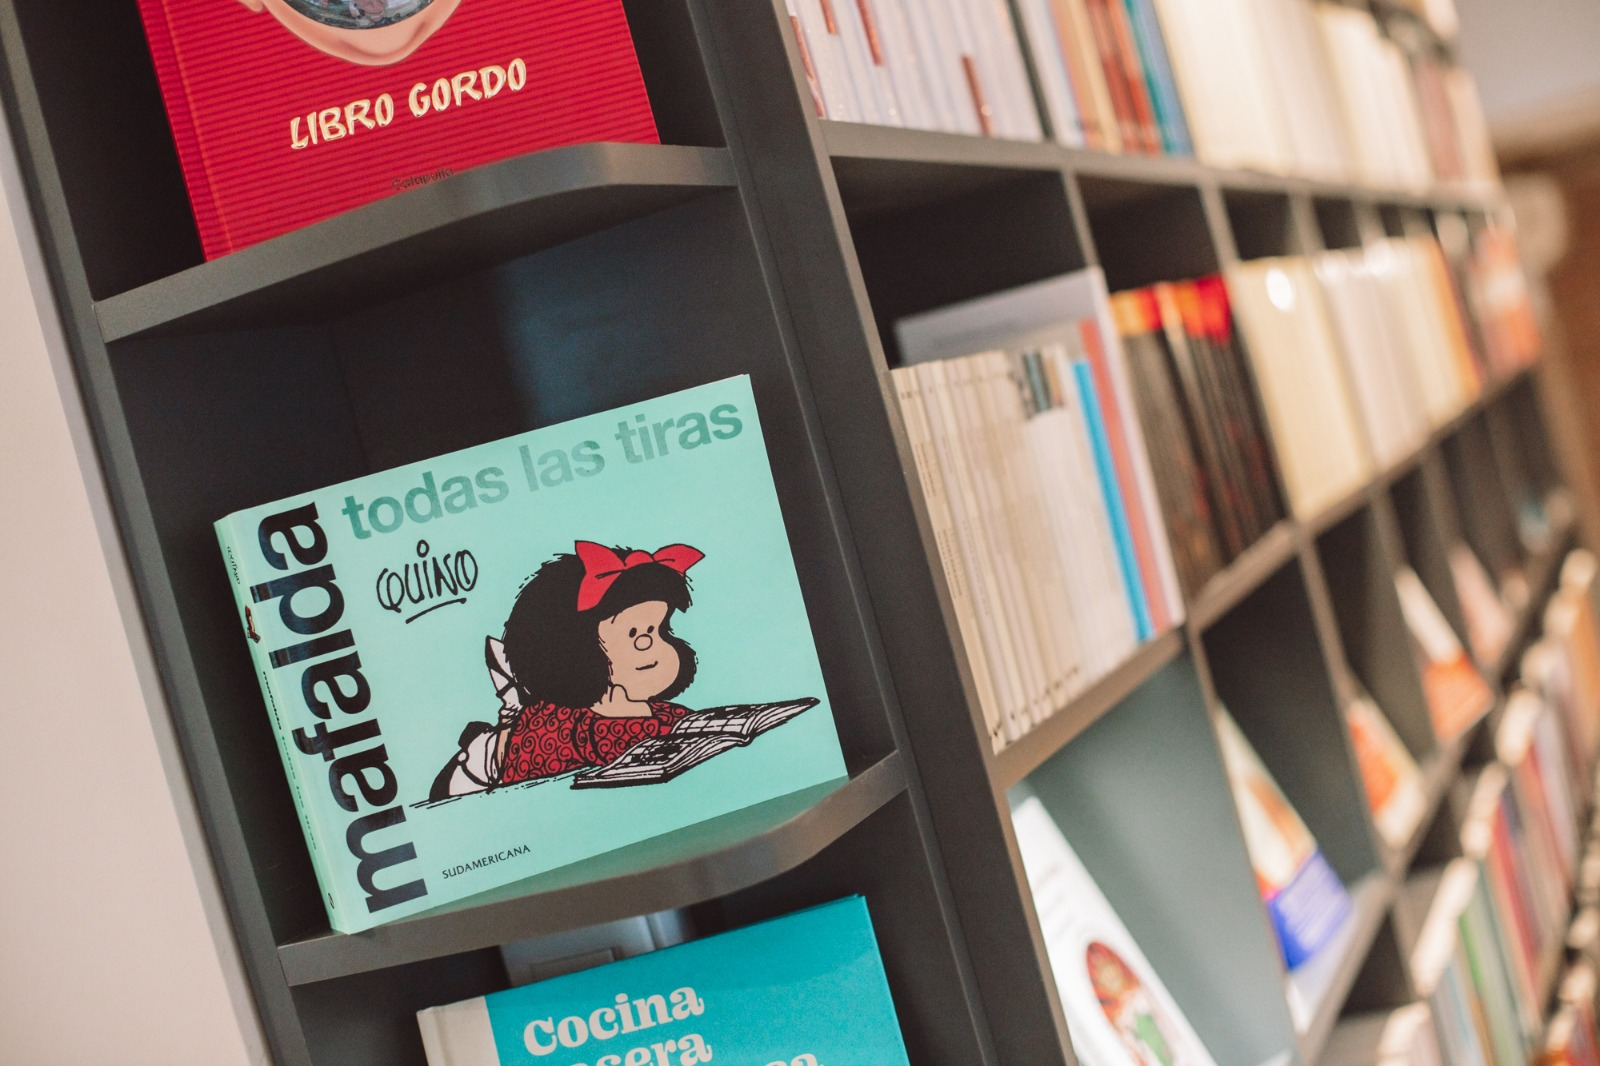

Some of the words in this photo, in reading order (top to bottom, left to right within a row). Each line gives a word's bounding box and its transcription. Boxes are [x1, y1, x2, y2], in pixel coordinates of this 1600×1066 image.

[290, 92, 395, 149] LIBRO
[408, 57, 527, 118] GORDO
[341, 465, 510, 540] todas
[518, 440, 605, 492] las
[614, 403, 743, 465] tiras
[376, 539, 479, 614] QUINO
[249, 501, 428, 914] mafalda
[441, 844, 531, 880] SUDAMERICANA
[523, 986, 705, 1056] Cocina
